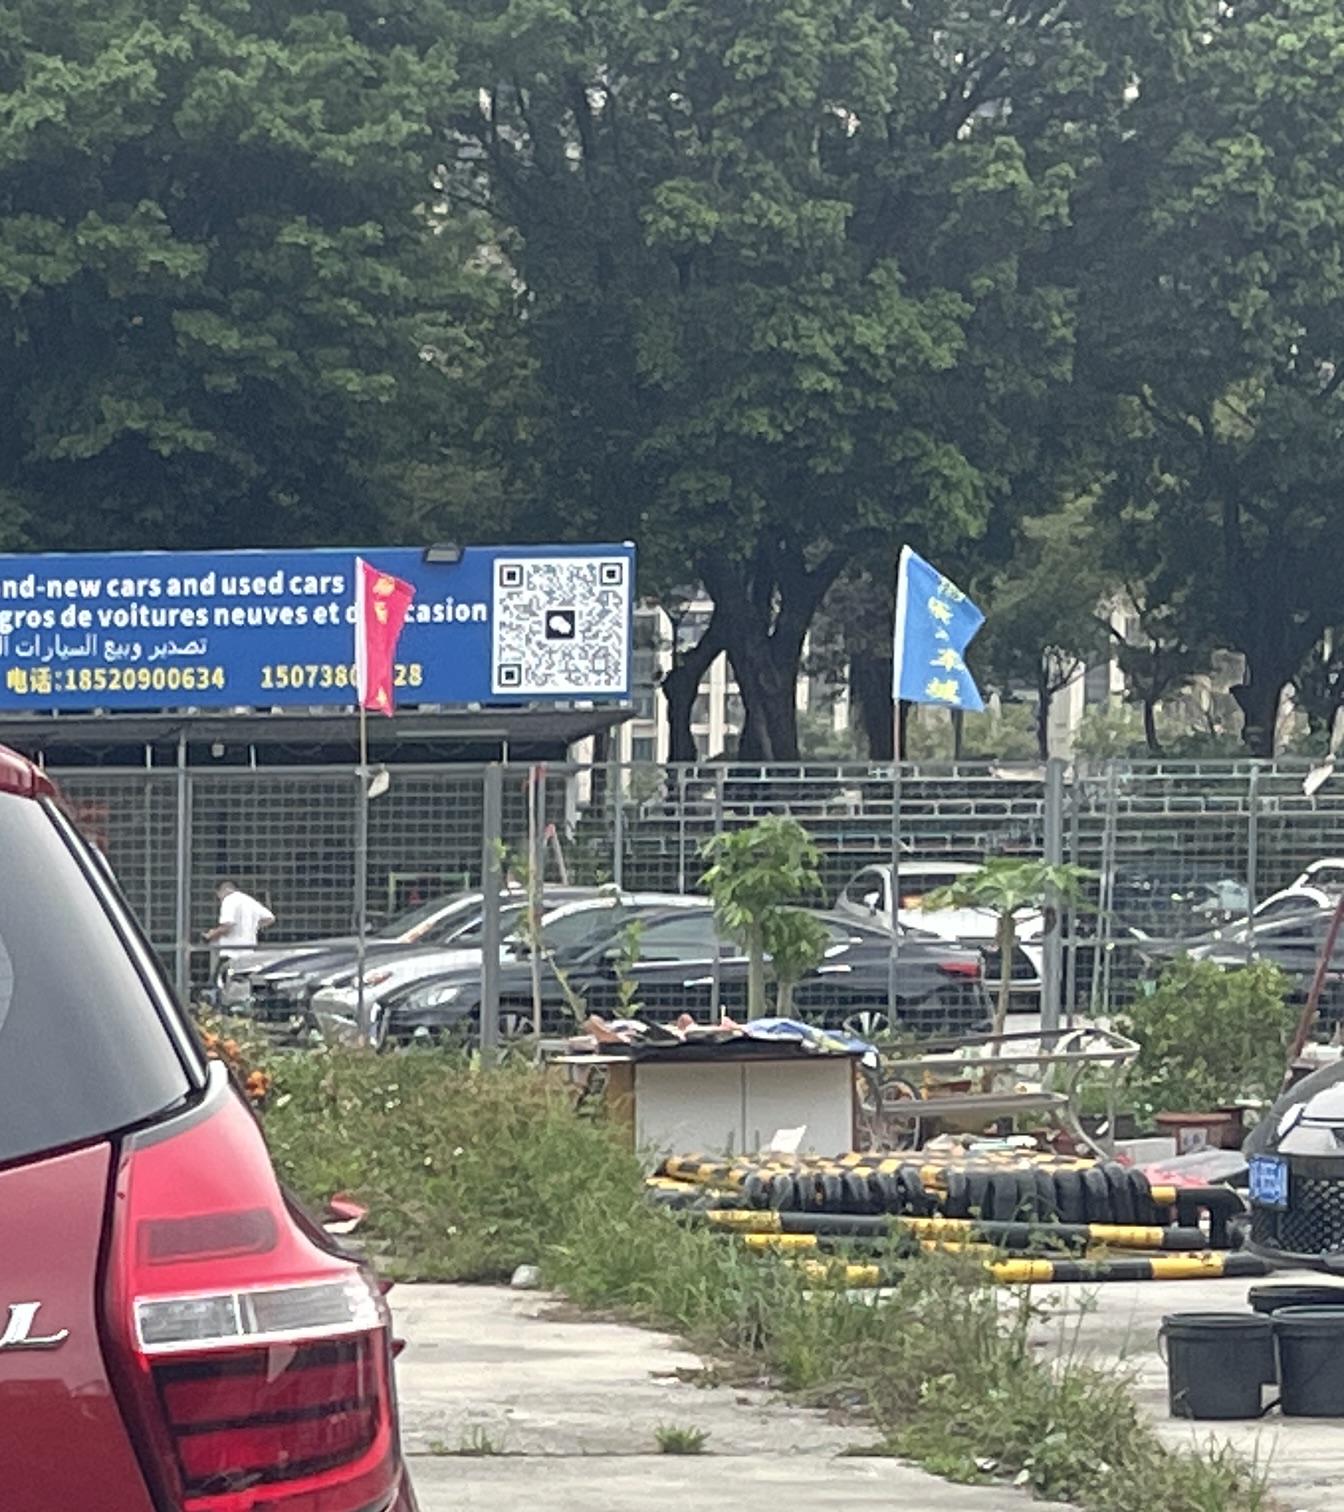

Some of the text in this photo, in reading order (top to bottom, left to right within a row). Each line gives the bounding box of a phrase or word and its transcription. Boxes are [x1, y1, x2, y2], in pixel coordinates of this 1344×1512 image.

[106, 577, 162, 598] cars
[166, 571, 216, 597] and
[221, 570, 284, 596] used
[289, 574, 345, 595] cars
[60, 603, 93, 627] de
[97, 602, 209, 627] voitures
[214, 606, 308, 625] neuves
[313, 602, 340, 625] et
[346, 596, 487, 624] dcasion
[15, 633, 98, 662] السيارات
[104, 639, 141, 662] وبيع
[149, 637, 208, 661] تصدير
[262, 663, 423, 689] 15073828
